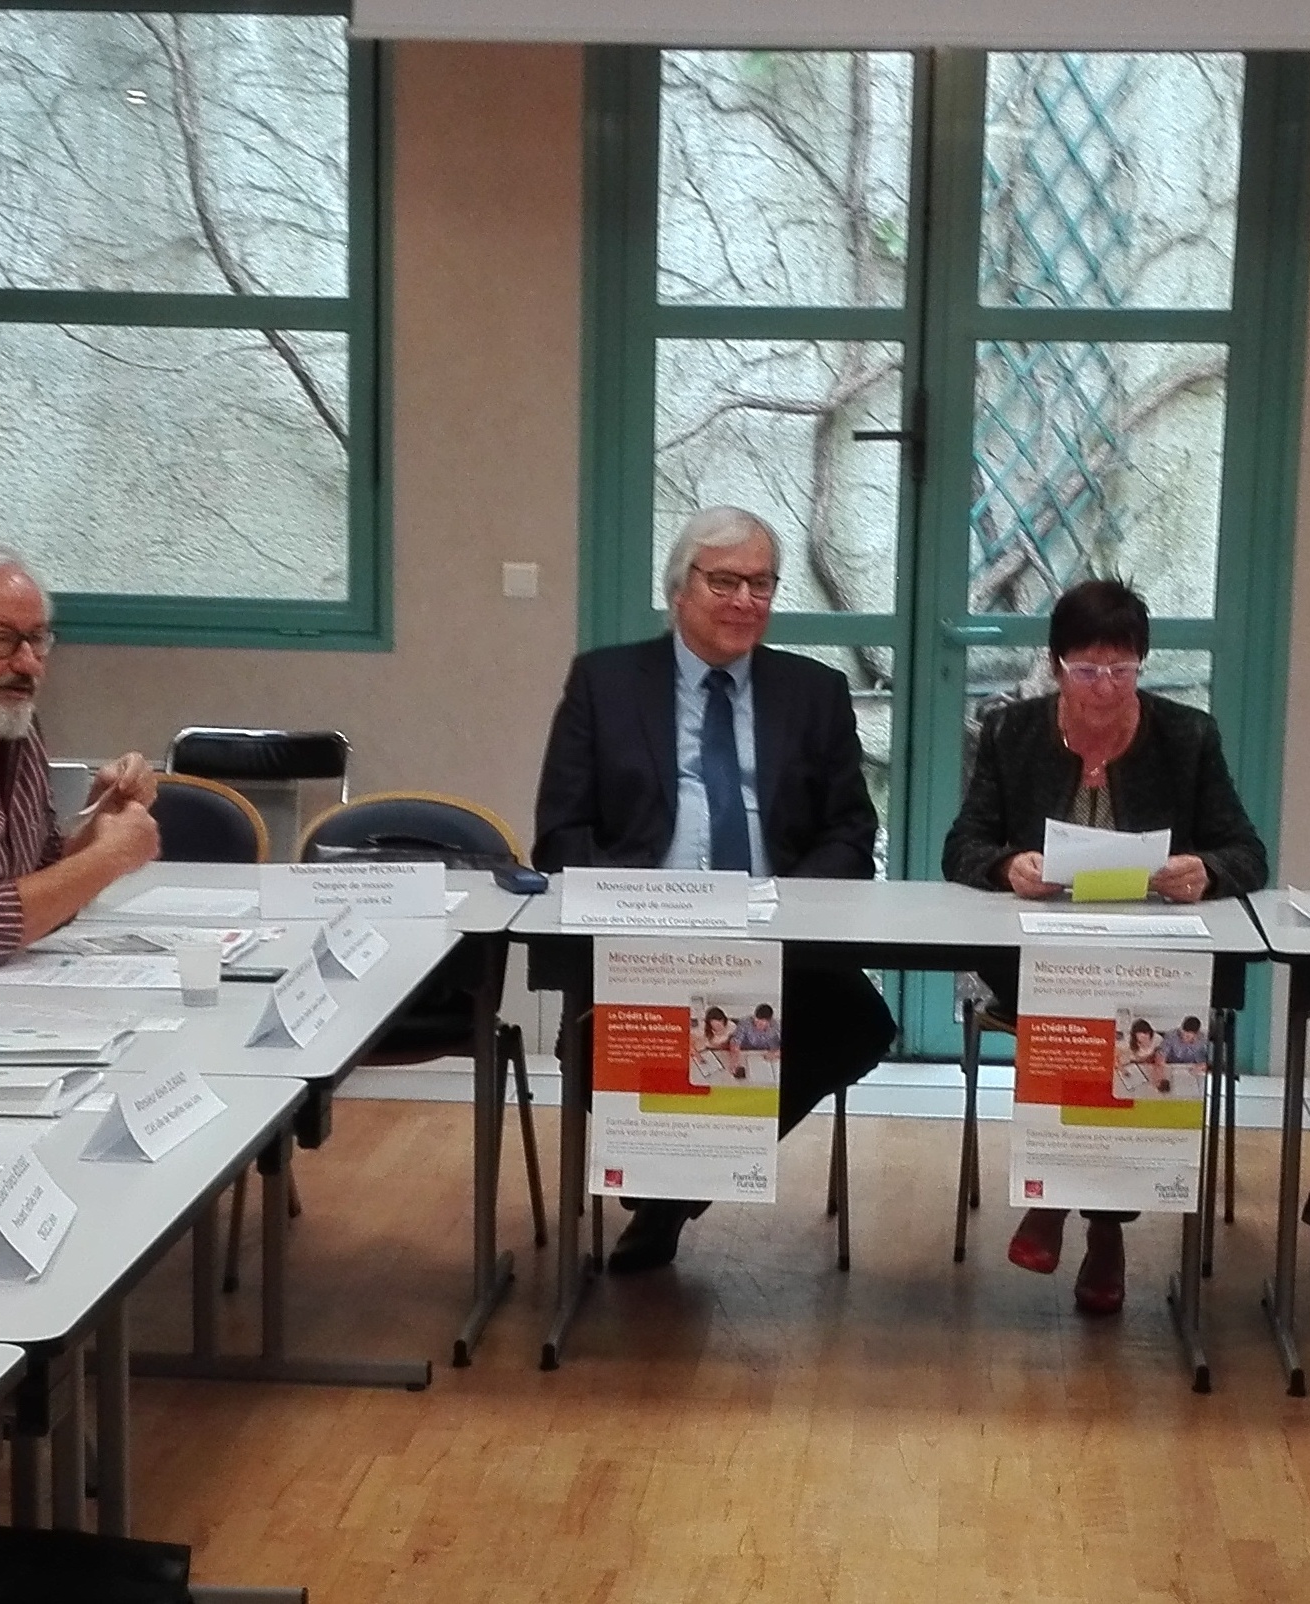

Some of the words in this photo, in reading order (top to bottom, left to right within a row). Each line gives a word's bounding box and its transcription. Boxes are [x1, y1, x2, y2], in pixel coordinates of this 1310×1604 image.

[608, 951, 674, 965] Microcrédit
[688, 952, 723, 967] Crédit
[725, 954, 753, 968] Elan
[1034, 961, 1101, 976] Microcrédit
[1115, 963, 1151, 978] Crédit
